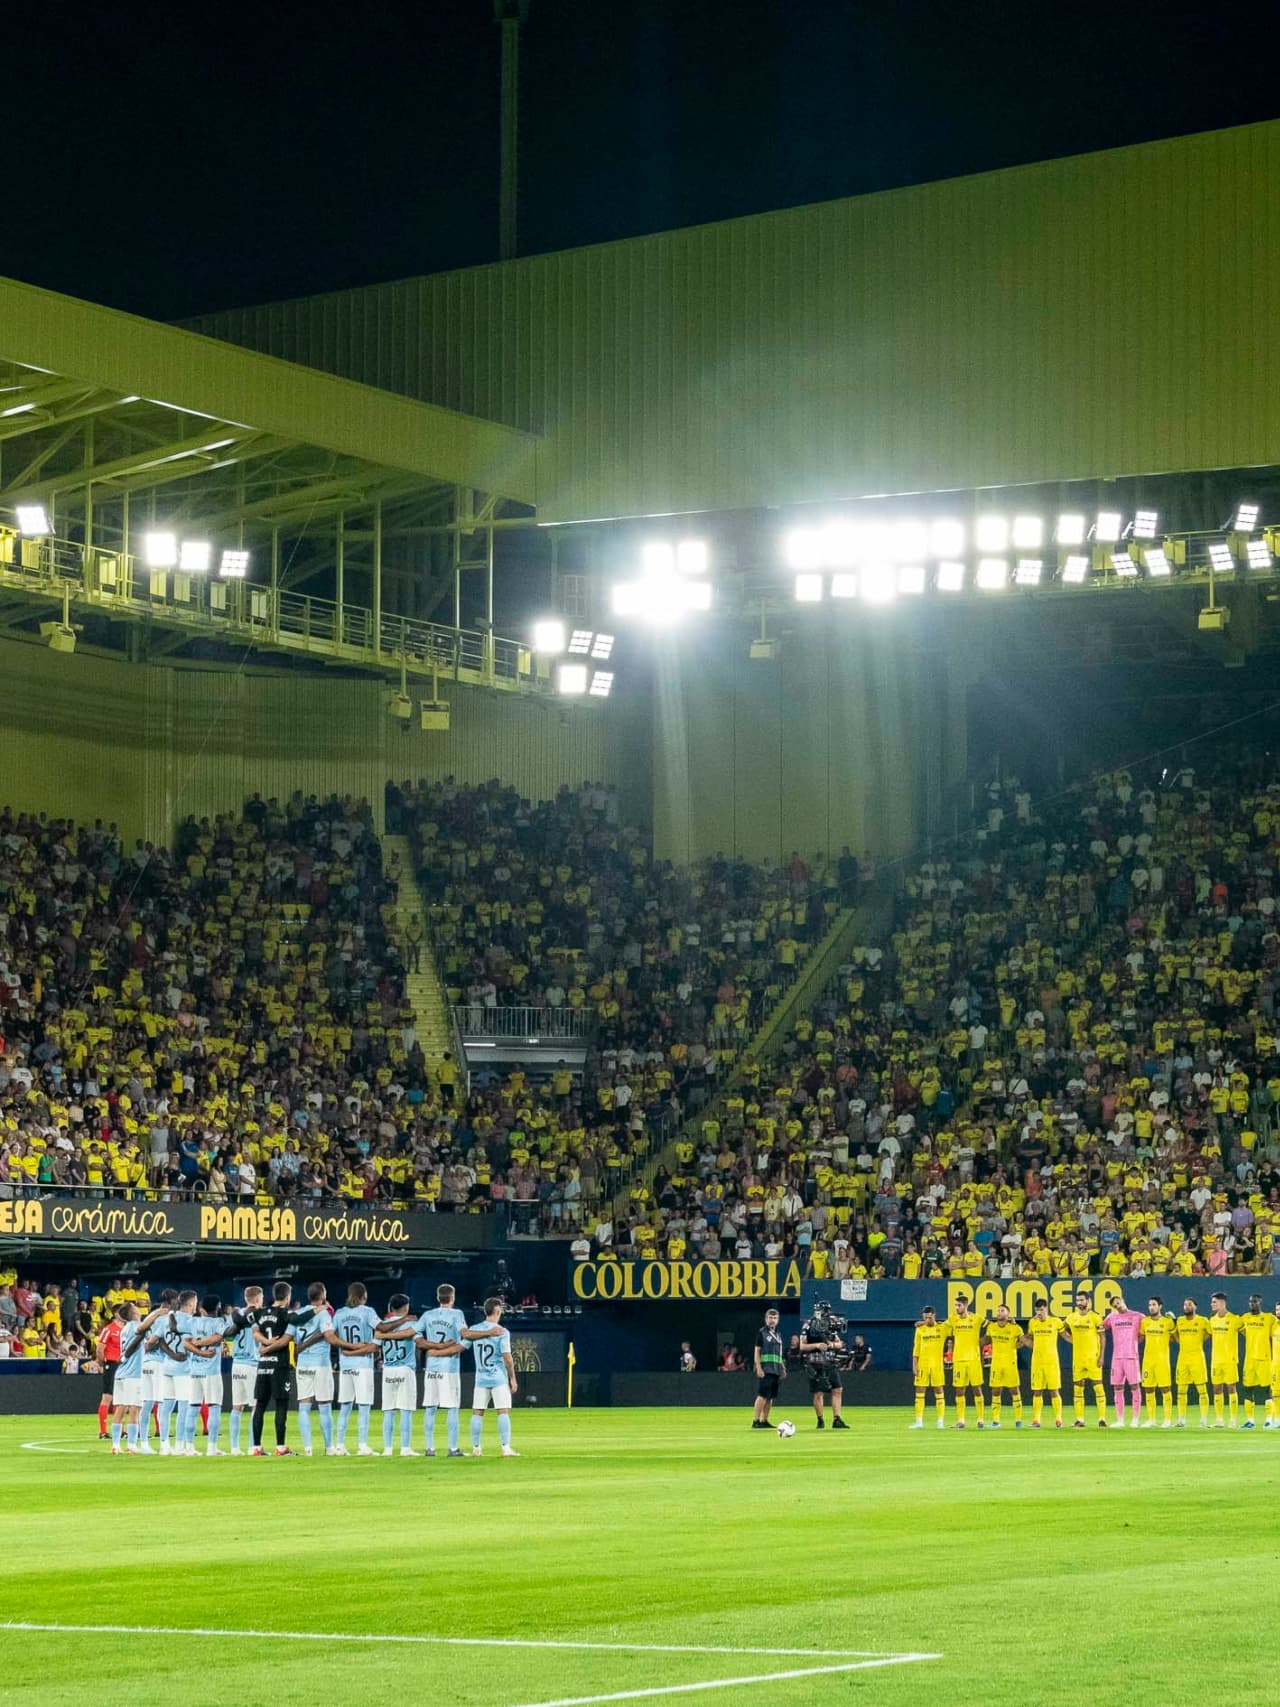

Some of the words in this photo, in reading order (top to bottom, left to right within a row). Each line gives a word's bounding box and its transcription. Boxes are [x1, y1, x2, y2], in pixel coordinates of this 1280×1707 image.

[201, 1206, 297, 1241] PAMESA
[573, 1259, 800, 1299] COLOROBBIA
[343, 1324, 361, 1344] 16
[383, 1339, 407, 1362] 25
[477, 1343, 495, 1368] 12
